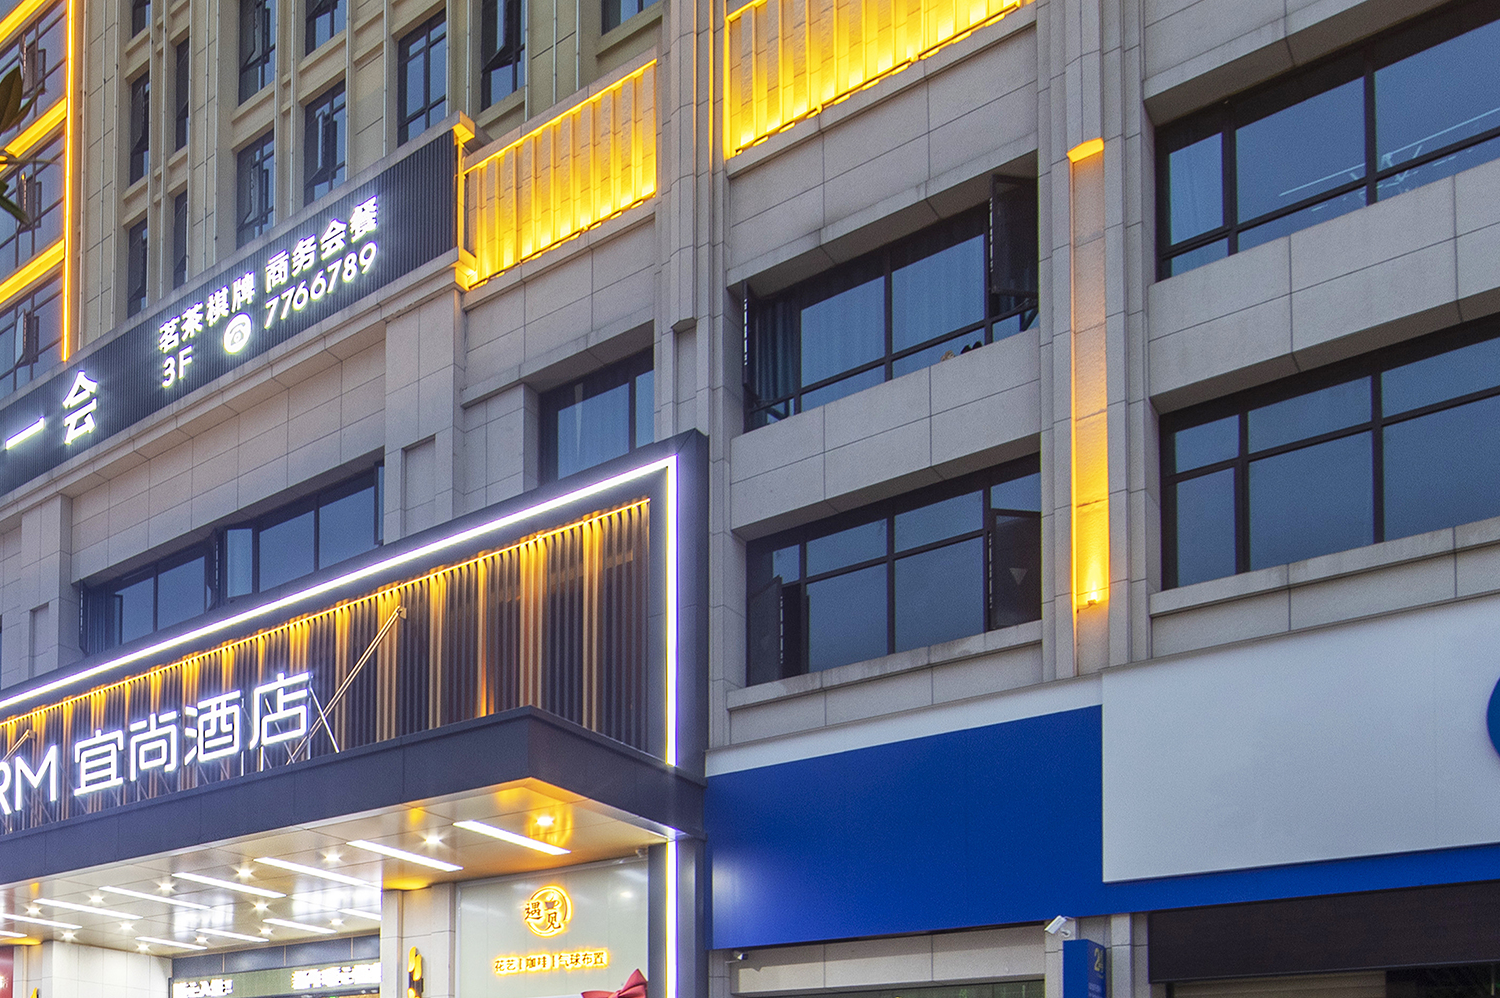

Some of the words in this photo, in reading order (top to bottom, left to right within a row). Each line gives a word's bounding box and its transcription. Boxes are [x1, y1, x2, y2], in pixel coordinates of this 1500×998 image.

[158, 271, 256, 353] 茗茶棋牌
[265, 194, 378, 293] 商务会餐
[162, 345, 193, 388] 3F
[264, 241, 378, 329] 7766789
[74, 671, 311, 798] 宜尚酒店
[524, 901, 561, 931] 遇见
